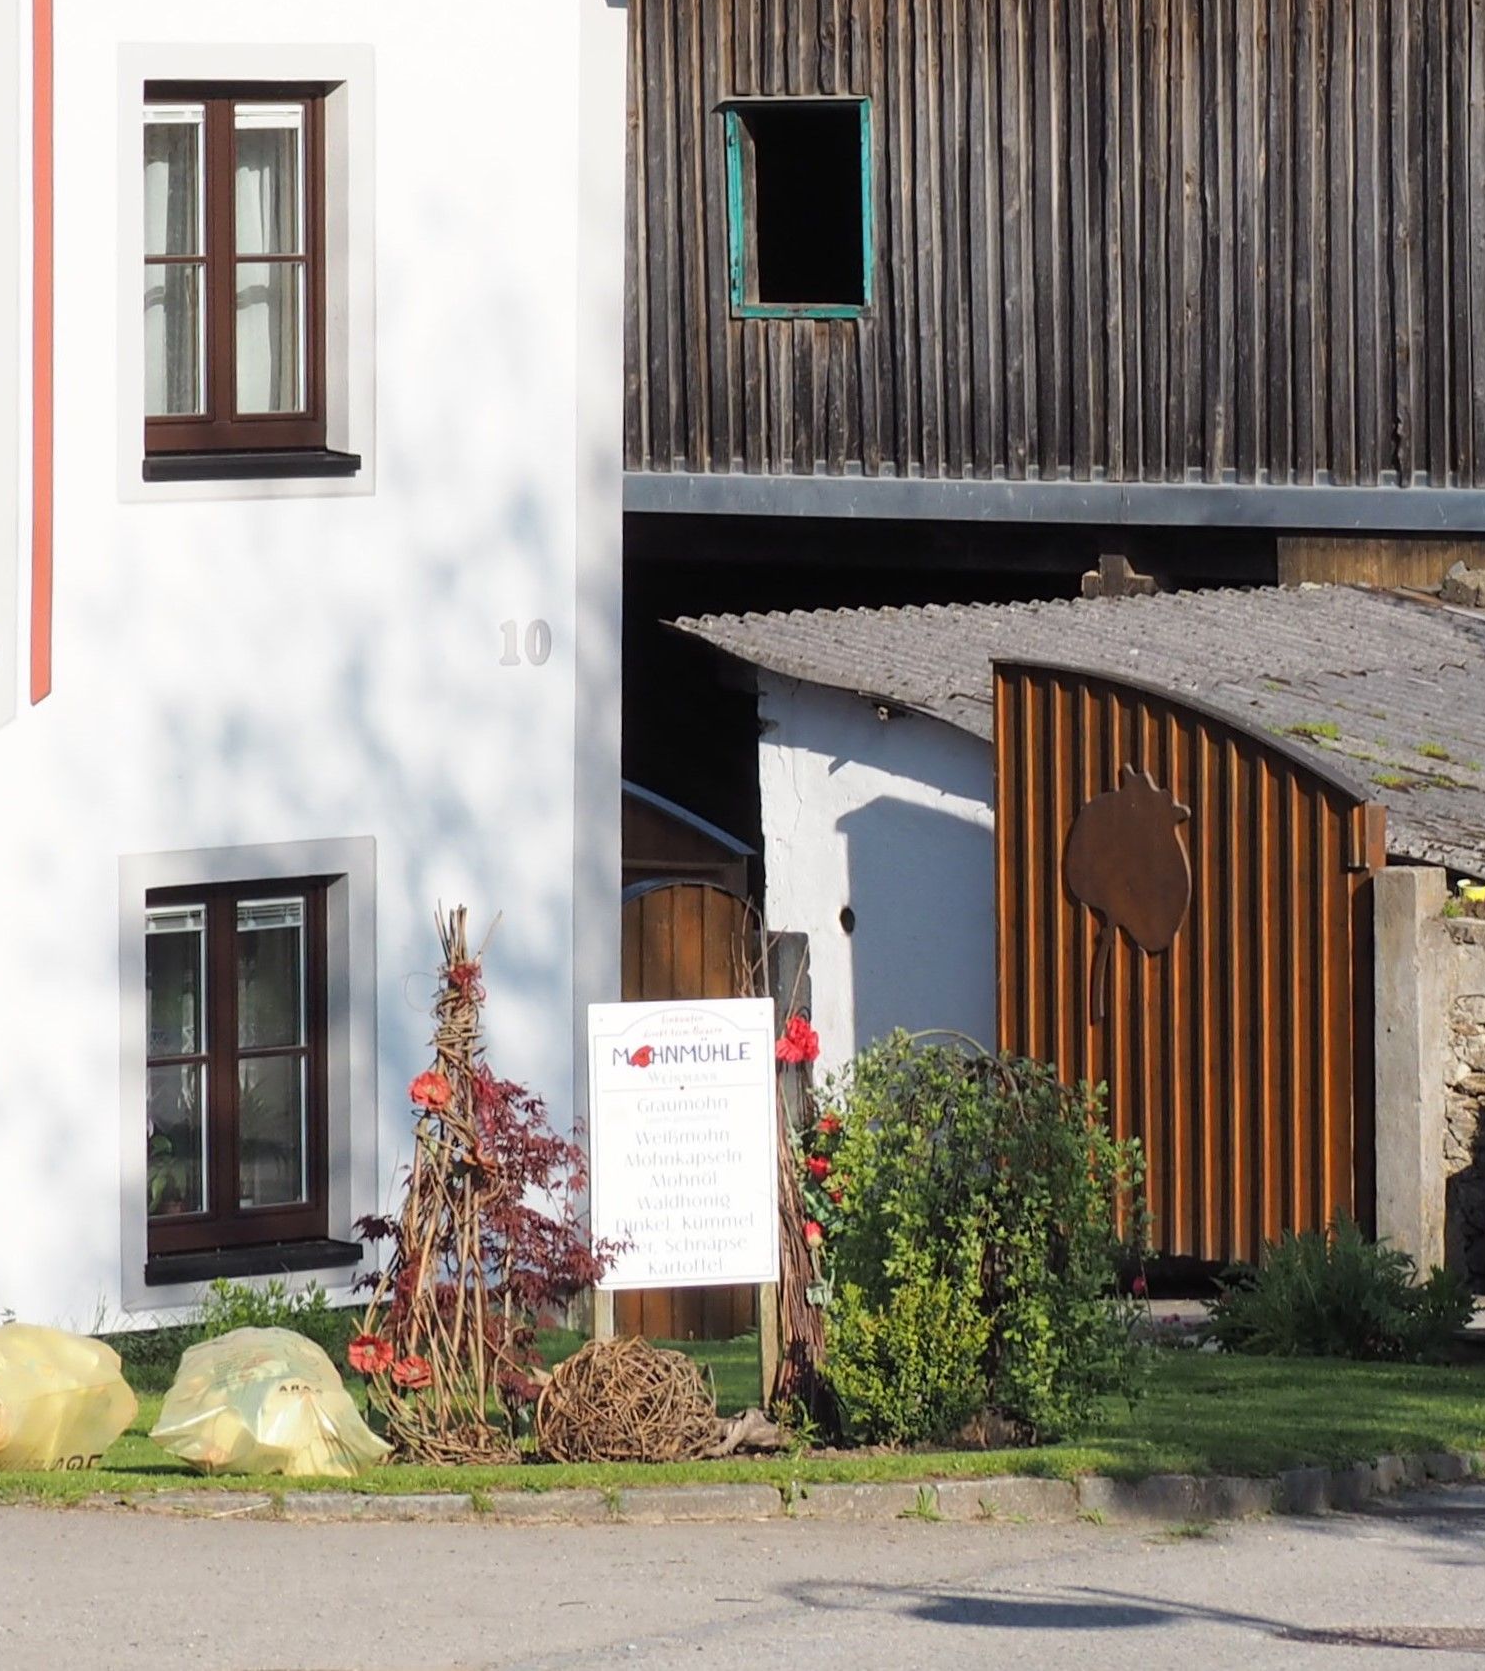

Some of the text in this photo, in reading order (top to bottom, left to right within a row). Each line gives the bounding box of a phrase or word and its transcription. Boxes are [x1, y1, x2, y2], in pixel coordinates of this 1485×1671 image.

[499, 619, 552, 667] 10
[637, 1095, 728, 1113] Graumohn
[635, 1128, 730, 1146] Weißmohn
[625, 1148, 742, 1168] Mohnkapseln
[650, 1170, 718, 1188] Mohnöl
[637, 1193, 731, 1210] Waldhonig
[682, 1211, 755, 1230] Kümmel
[666, 1236, 748, 1255] Schnäpse
[648, 1258, 723, 1275] Kartoffel
